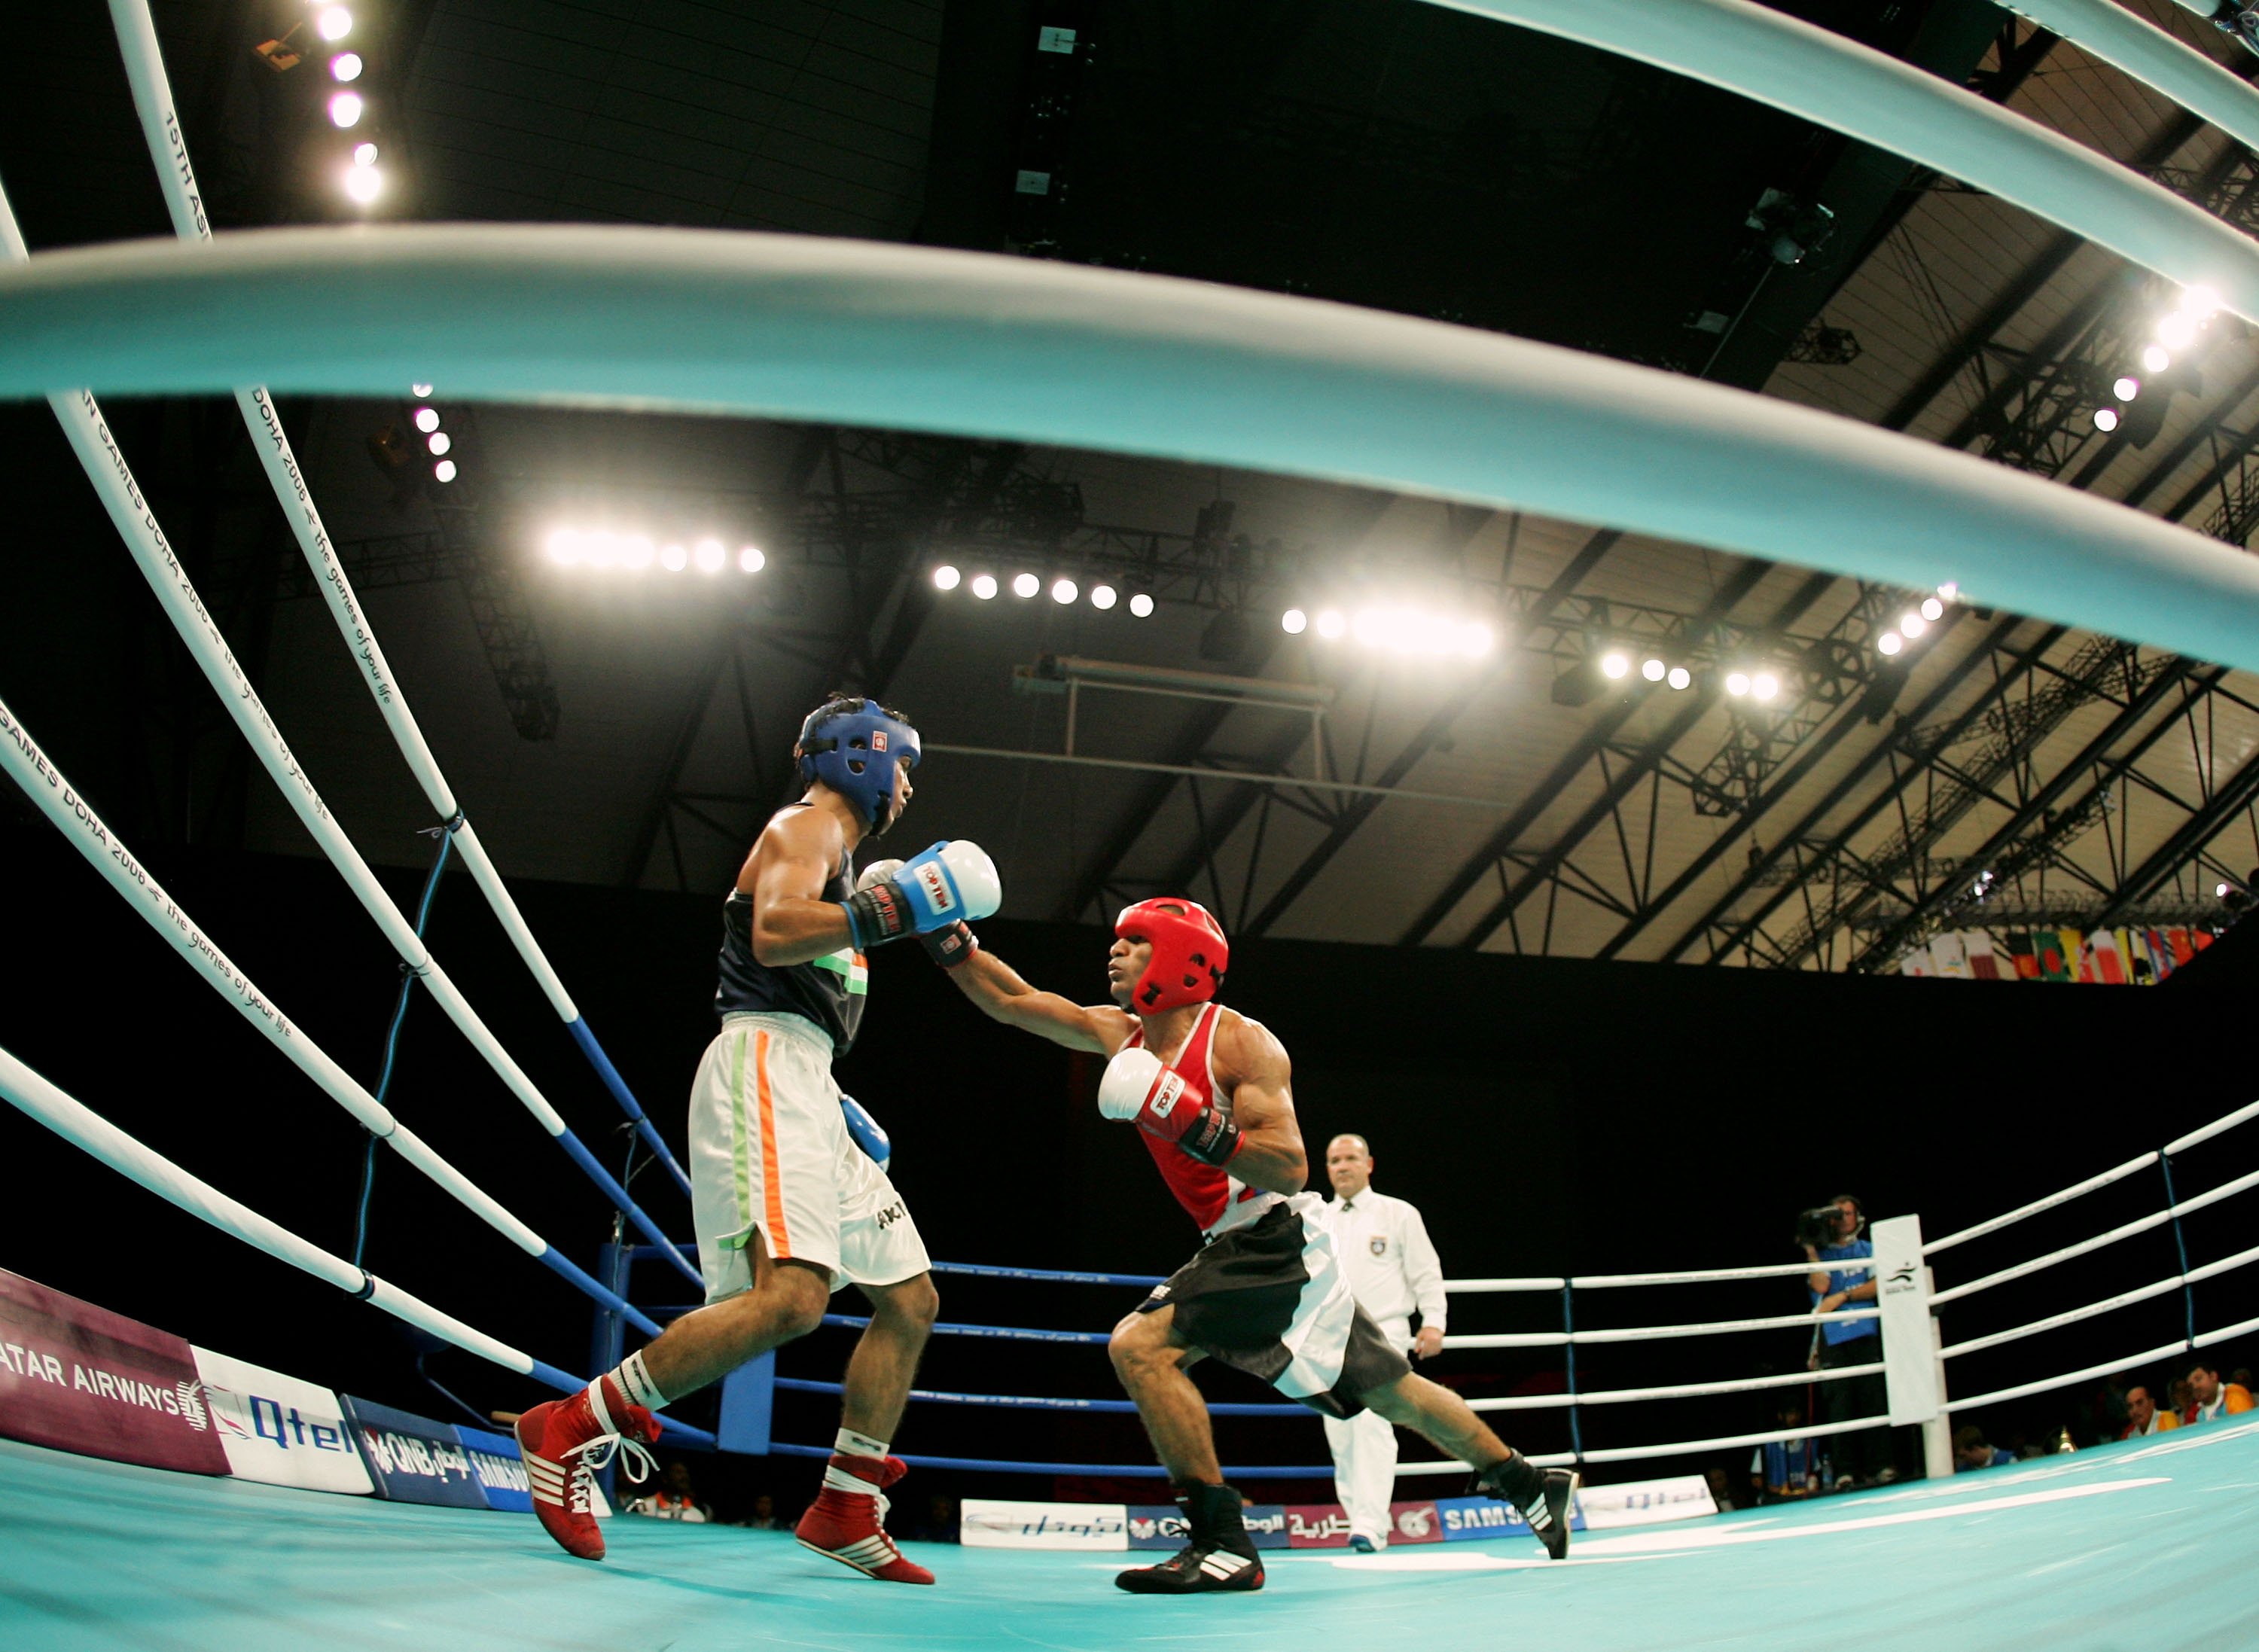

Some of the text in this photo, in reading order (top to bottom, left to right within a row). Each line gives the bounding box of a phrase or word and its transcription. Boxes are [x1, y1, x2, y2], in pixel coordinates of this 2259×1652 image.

[166, 112, 211, 242] 15TH ASI
[99, 423, 143, 510] GAMES
[145, 514, 179, 578] DOHA
[252, 388, 392, 704] DOHA 2006 the games of your life
[63, 788, 108, 846] DOHA
[111, 843, 145, 885] 2006
[166, 902, 187, 931] the
[188, 931, 232, 978] games
[235, 978, 248, 995] of
[245, 991, 274, 1020] your
[276, 1015, 291, 1037] life
[0, 1343, 180, 1416] ATAR AIRWAYS
[249, 1395, 353, 1453] Qtel
[386, 1432, 436, 1477] QNB
[468, 1450, 530, 1493] SAMSU
